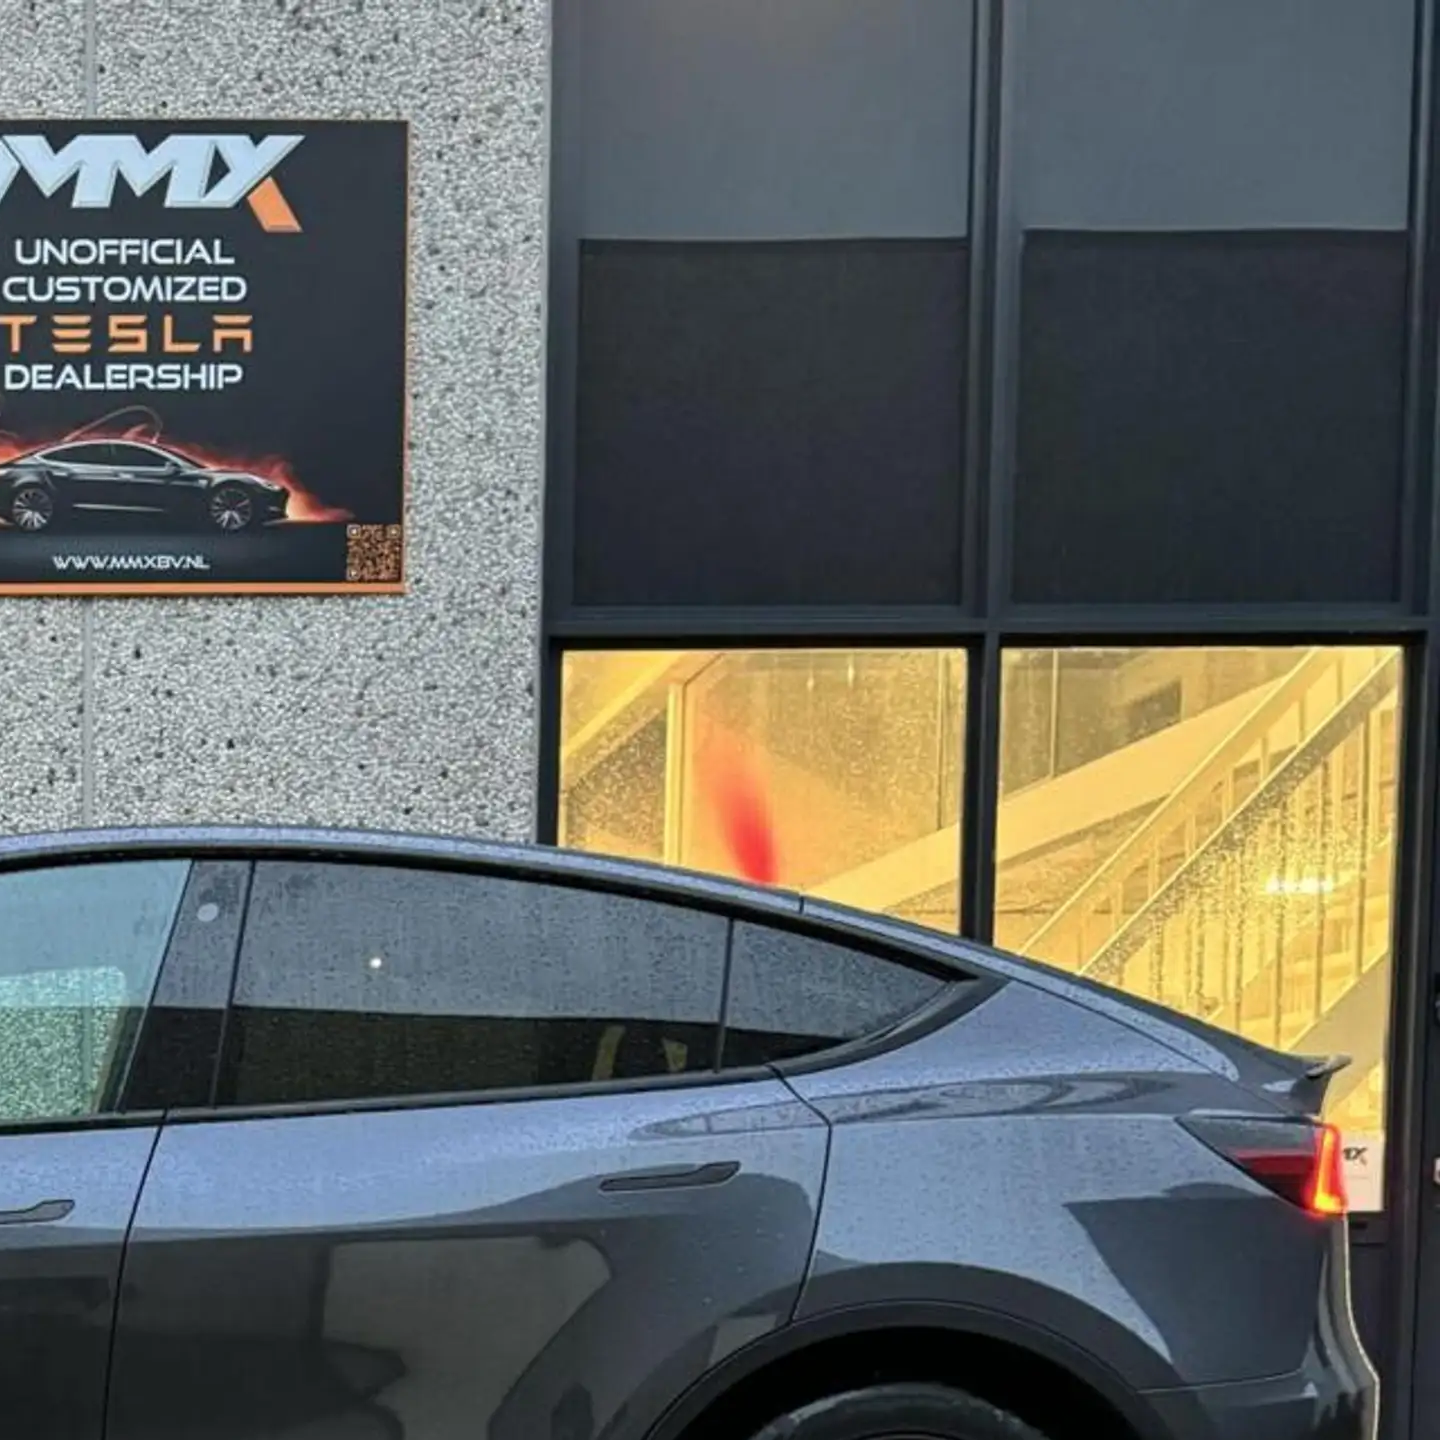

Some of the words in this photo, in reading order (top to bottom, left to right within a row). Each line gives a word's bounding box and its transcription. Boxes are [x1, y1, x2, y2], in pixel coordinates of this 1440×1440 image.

[15, 239, 235, 265] UNOFFICIAL
[2, 276, 247, 302] CUSTOMIZED
[4, 364, 243, 390] DEALERSHIP
[52, 555, 210, 570] WWW.MMXBV.NL
